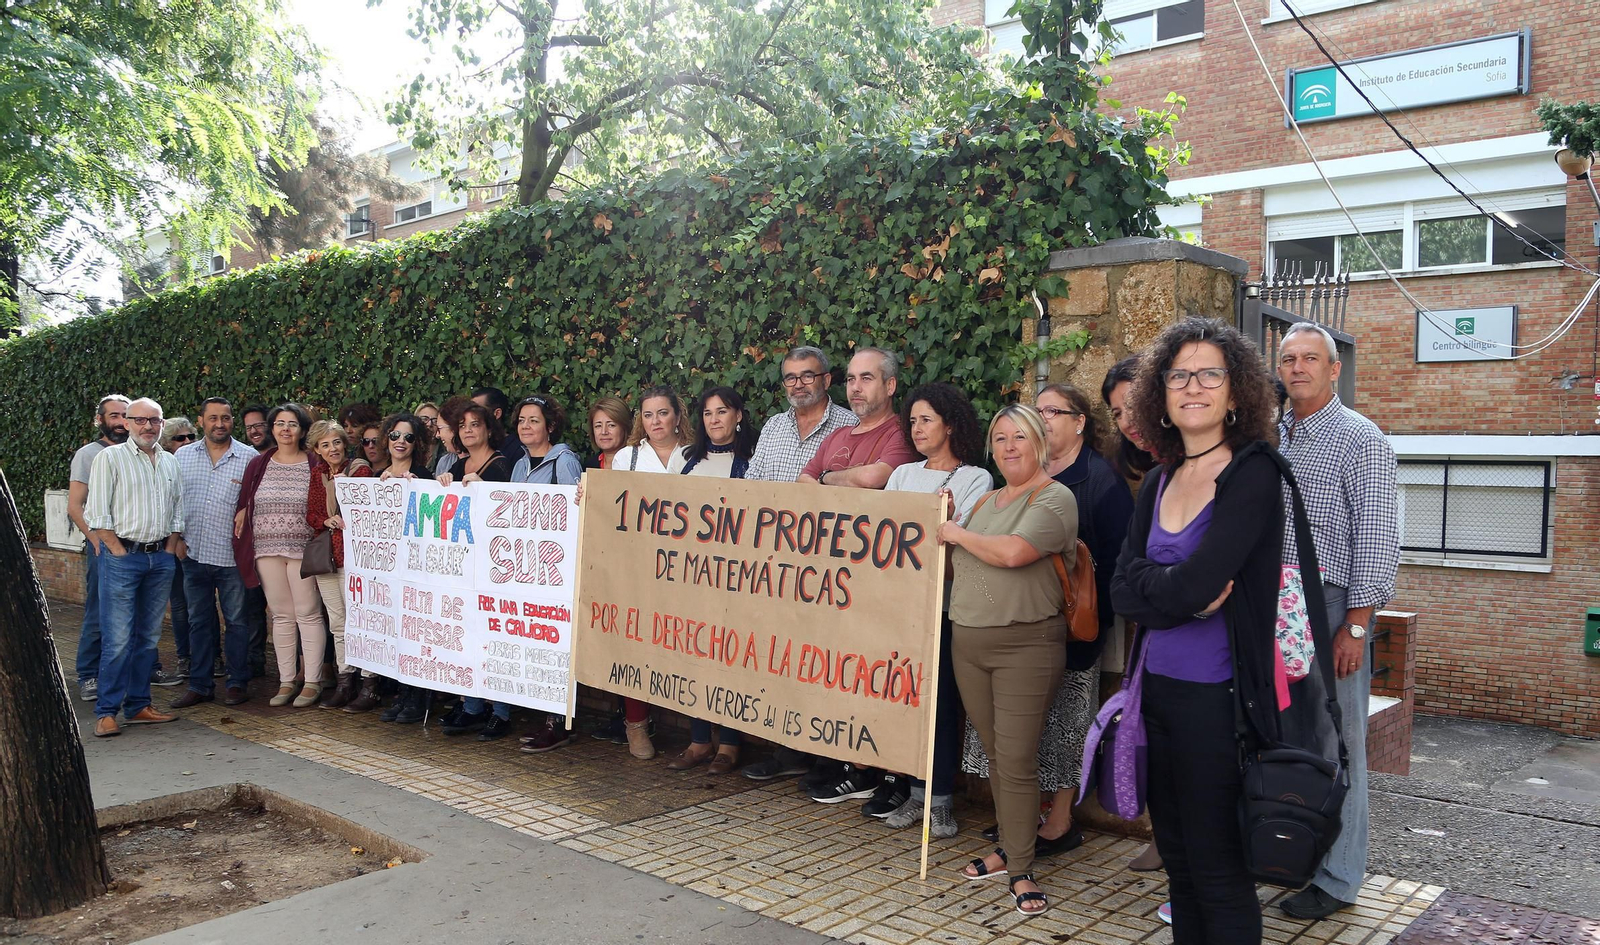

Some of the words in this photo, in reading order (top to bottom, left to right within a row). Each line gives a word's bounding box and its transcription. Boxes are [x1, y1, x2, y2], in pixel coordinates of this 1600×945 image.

[1360, 76, 1394, 88] Instituto
[1396, 72, 1407, 82] de
[1408, 64, 1454, 80] Educación
[1456, 56, 1507, 73] Secundaria
[1432, 341, 1461, 351] Centro
[337, 482, 371, 506] IES
[373, 483, 403, 508] FCO
[486, 490, 568, 532] ZONA
[350, 509, 404, 540] ROMERO
[403, 490, 475, 545] AMPA
[614, 490, 629, 532] 1
[636, 495, 690, 540] MES
[753, 507, 927, 571] PROFESOR
[351, 539, 397, 572] VARGAS
[489, 535, 565, 587] SUR
[347, 572, 365, 606] 49
[655, 548, 679, 581] DE
[683, 552, 853, 611] MATEMÁTICAS
[402, 585, 434, 614] FALTA
[440, 594, 465, 621] DE
[478, 594, 496, 613] POR
[499, 598, 518, 616] UNA
[400, 613, 465, 652] PROFESOR
[488, 617, 501, 633] DE
[504, 618, 560, 644] CALIDAD
[420, 645, 432, 658] DE
[590, 601, 620, 636] POR
[625, 607, 643, 643] EL
[653, 611, 740, 667] DERECHO
[742, 631, 759, 672] A
[767, 634, 791, 678] LA
[797, 643, 924, 708] EDUCACIÓN
[608, 662, 642, 691] AMPA
[763, 705, 777, 728] del
[782, 704, 803, 738] IES
